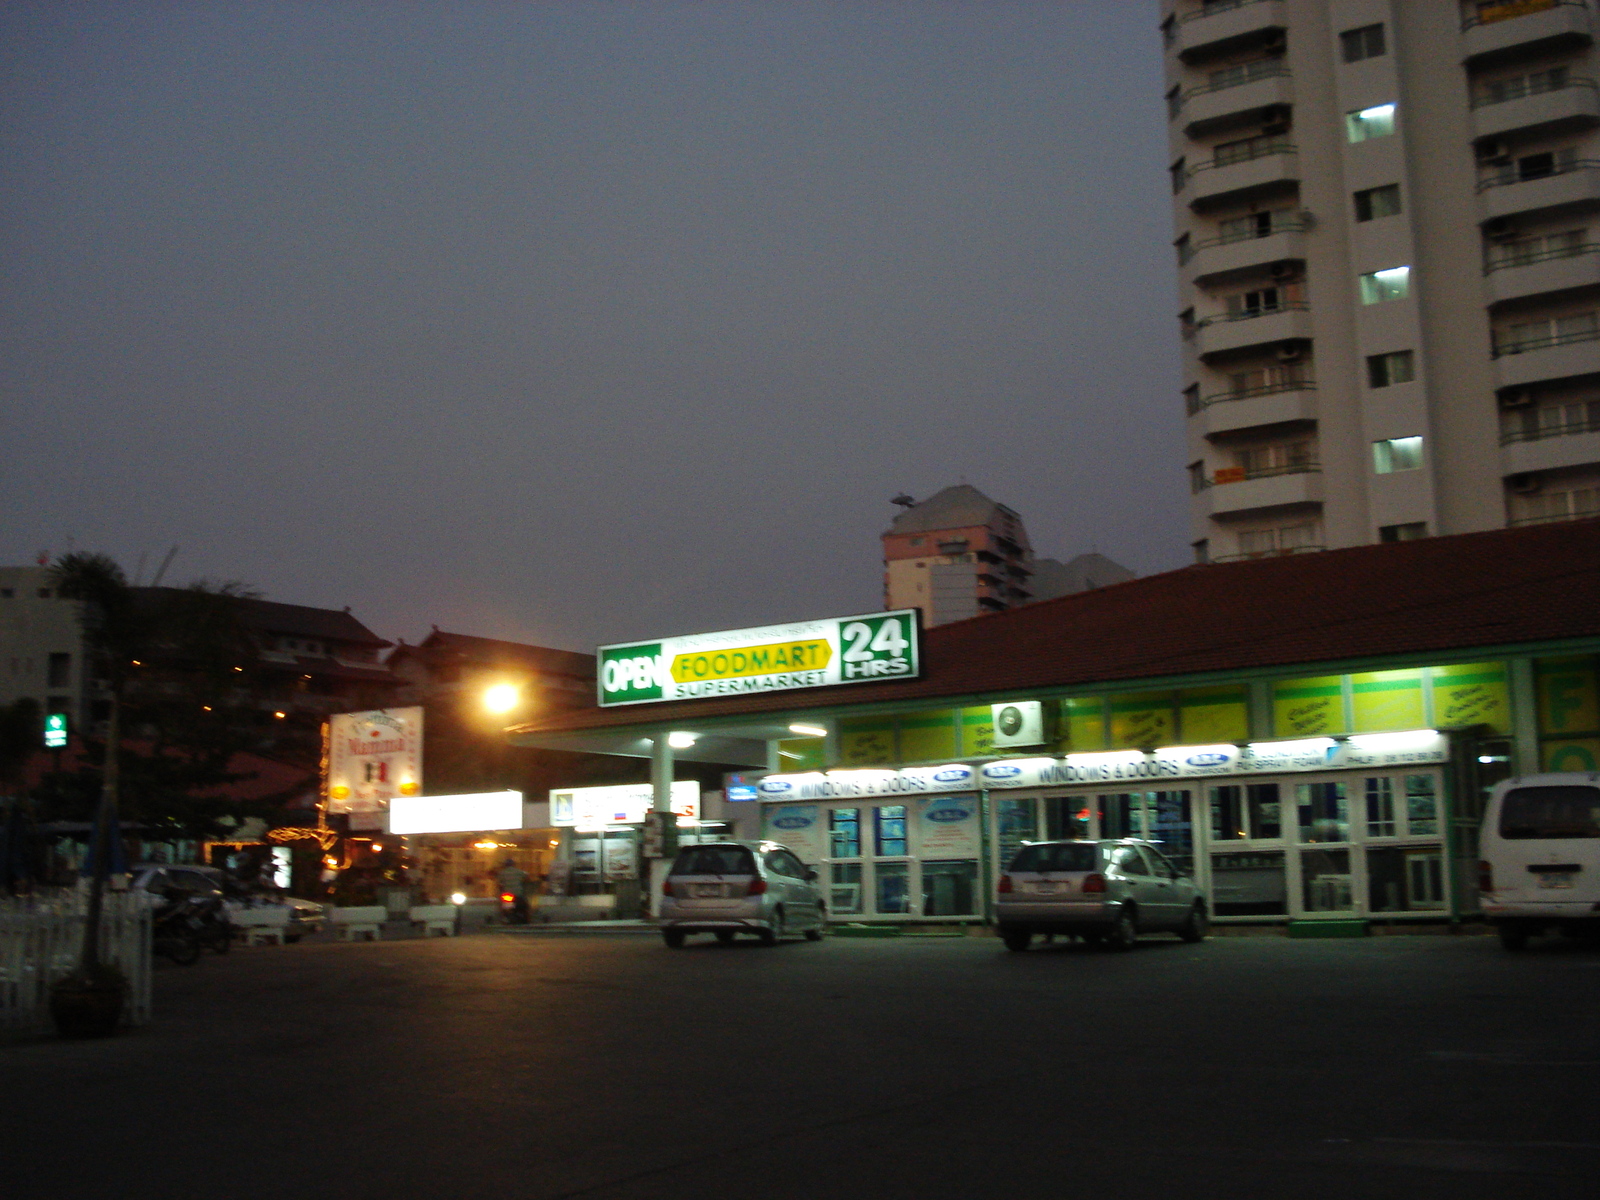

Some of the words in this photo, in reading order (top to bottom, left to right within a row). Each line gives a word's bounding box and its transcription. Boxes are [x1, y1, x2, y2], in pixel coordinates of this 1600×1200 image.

[841, 618, 909, 663] 24
[602, 654, 662, 693] OPEN
[680, 643, 820, 678] FOODMART
[845, 657, 909, 678] HRS
[675, 671, 828, 697] SUPERMARKET
[1039, 763, 1110, 783] WINDOWS
[1114, 766, 1124, 779] &
[1127, 758, 1179, 777] DOORS
[800, 779, 860, 798] WINDOWS
[881, 775, 928, 793] DOORS
